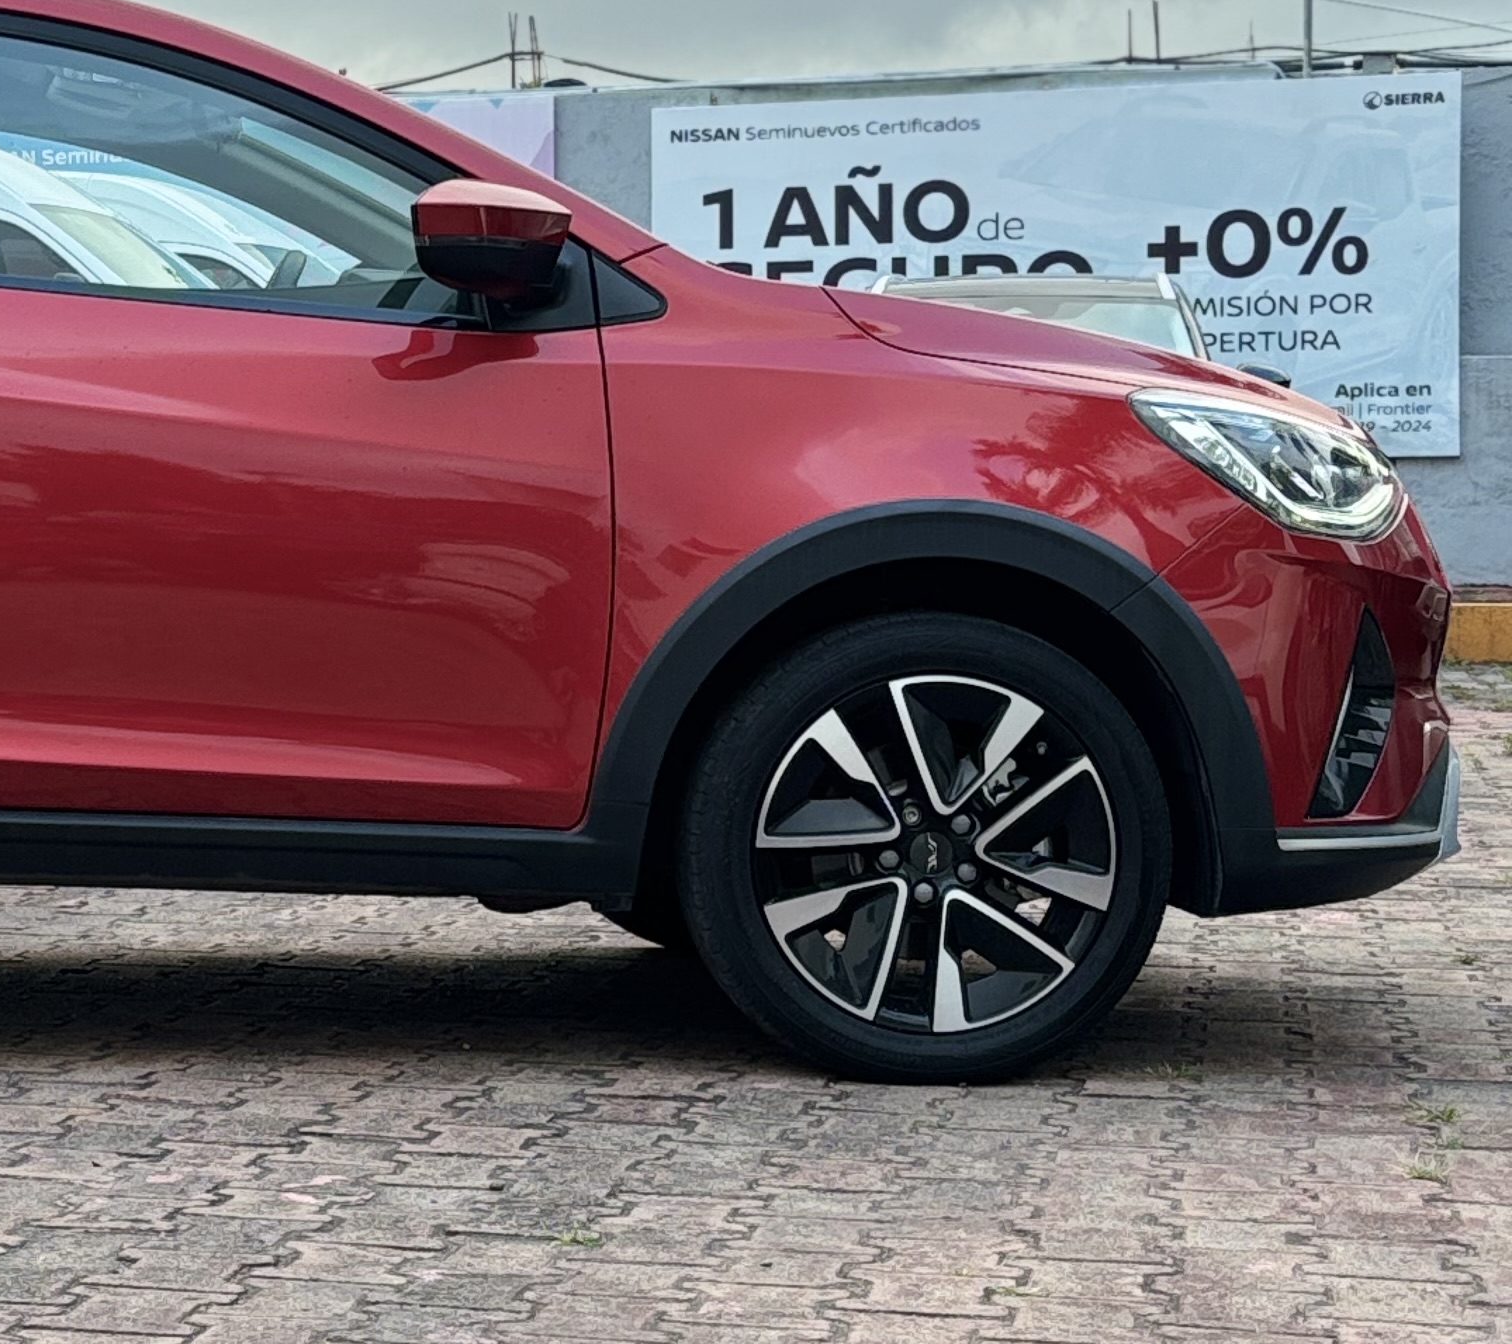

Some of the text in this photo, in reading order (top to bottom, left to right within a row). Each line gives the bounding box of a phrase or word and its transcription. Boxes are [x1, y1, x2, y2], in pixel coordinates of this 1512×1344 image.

[1384, 91, 1445, 106] SIERRA
[670, 117, 982, 144] NISSAN Seminuevos Certificados
[702, 164, 1026, 250] 1 AÑO de
[1147, 205, 1369, 279] +0%
[1193, 289, 1374, 319] MISIÓN POR
[1202, 329, 1341, 353] PERTURA
[1335, 382, 1432, 401] Aplica en
[1367, 402, 1433, 416] Frontier
[1391, 420, 1433, 433] 2024
